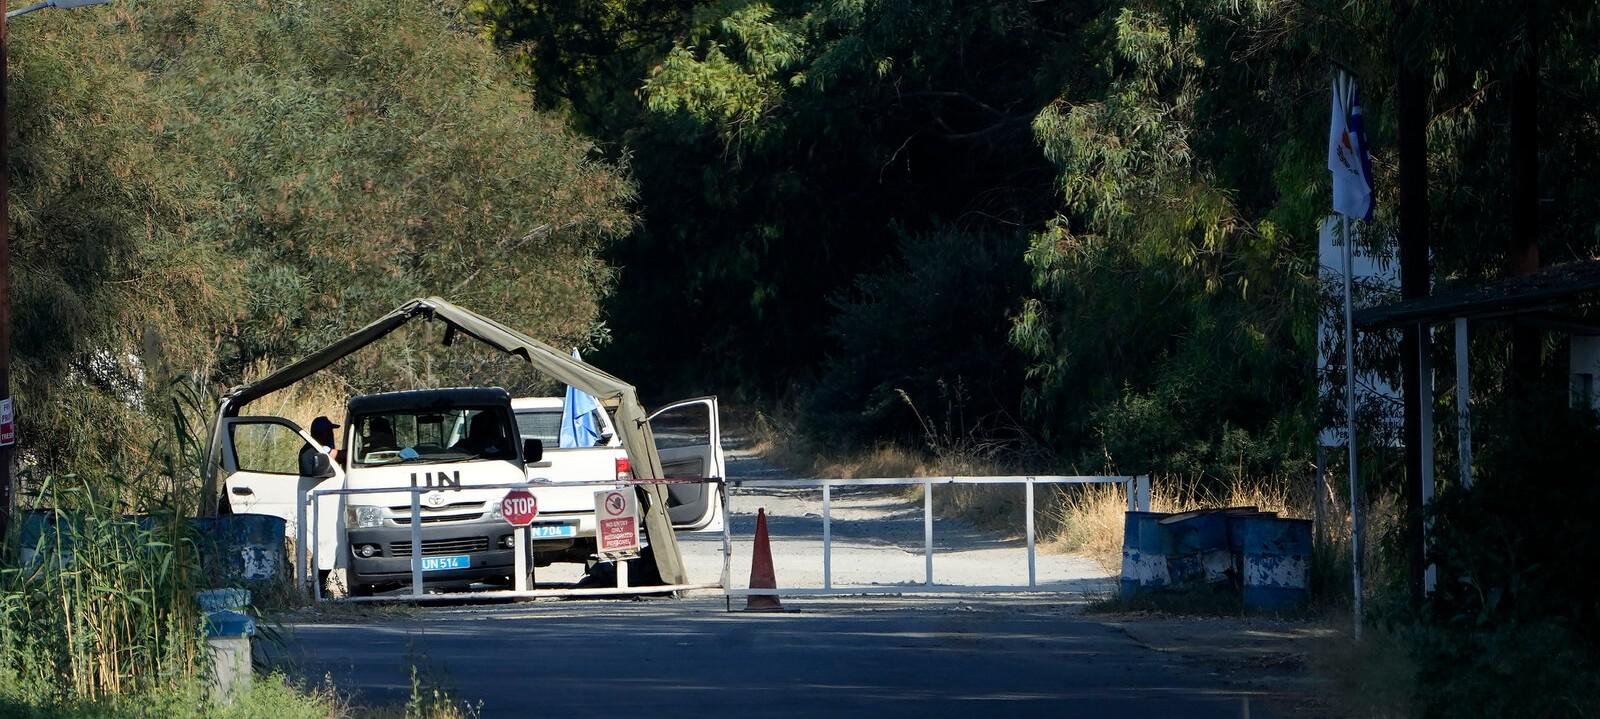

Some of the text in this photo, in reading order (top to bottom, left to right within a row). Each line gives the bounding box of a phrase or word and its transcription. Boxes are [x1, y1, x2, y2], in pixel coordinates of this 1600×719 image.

[410, 471, 460, 493] UN
[504, 498, 535, 516] STOP
[542, 526, 562, 536] 704
[422, 558, 459, 569] UN 514
